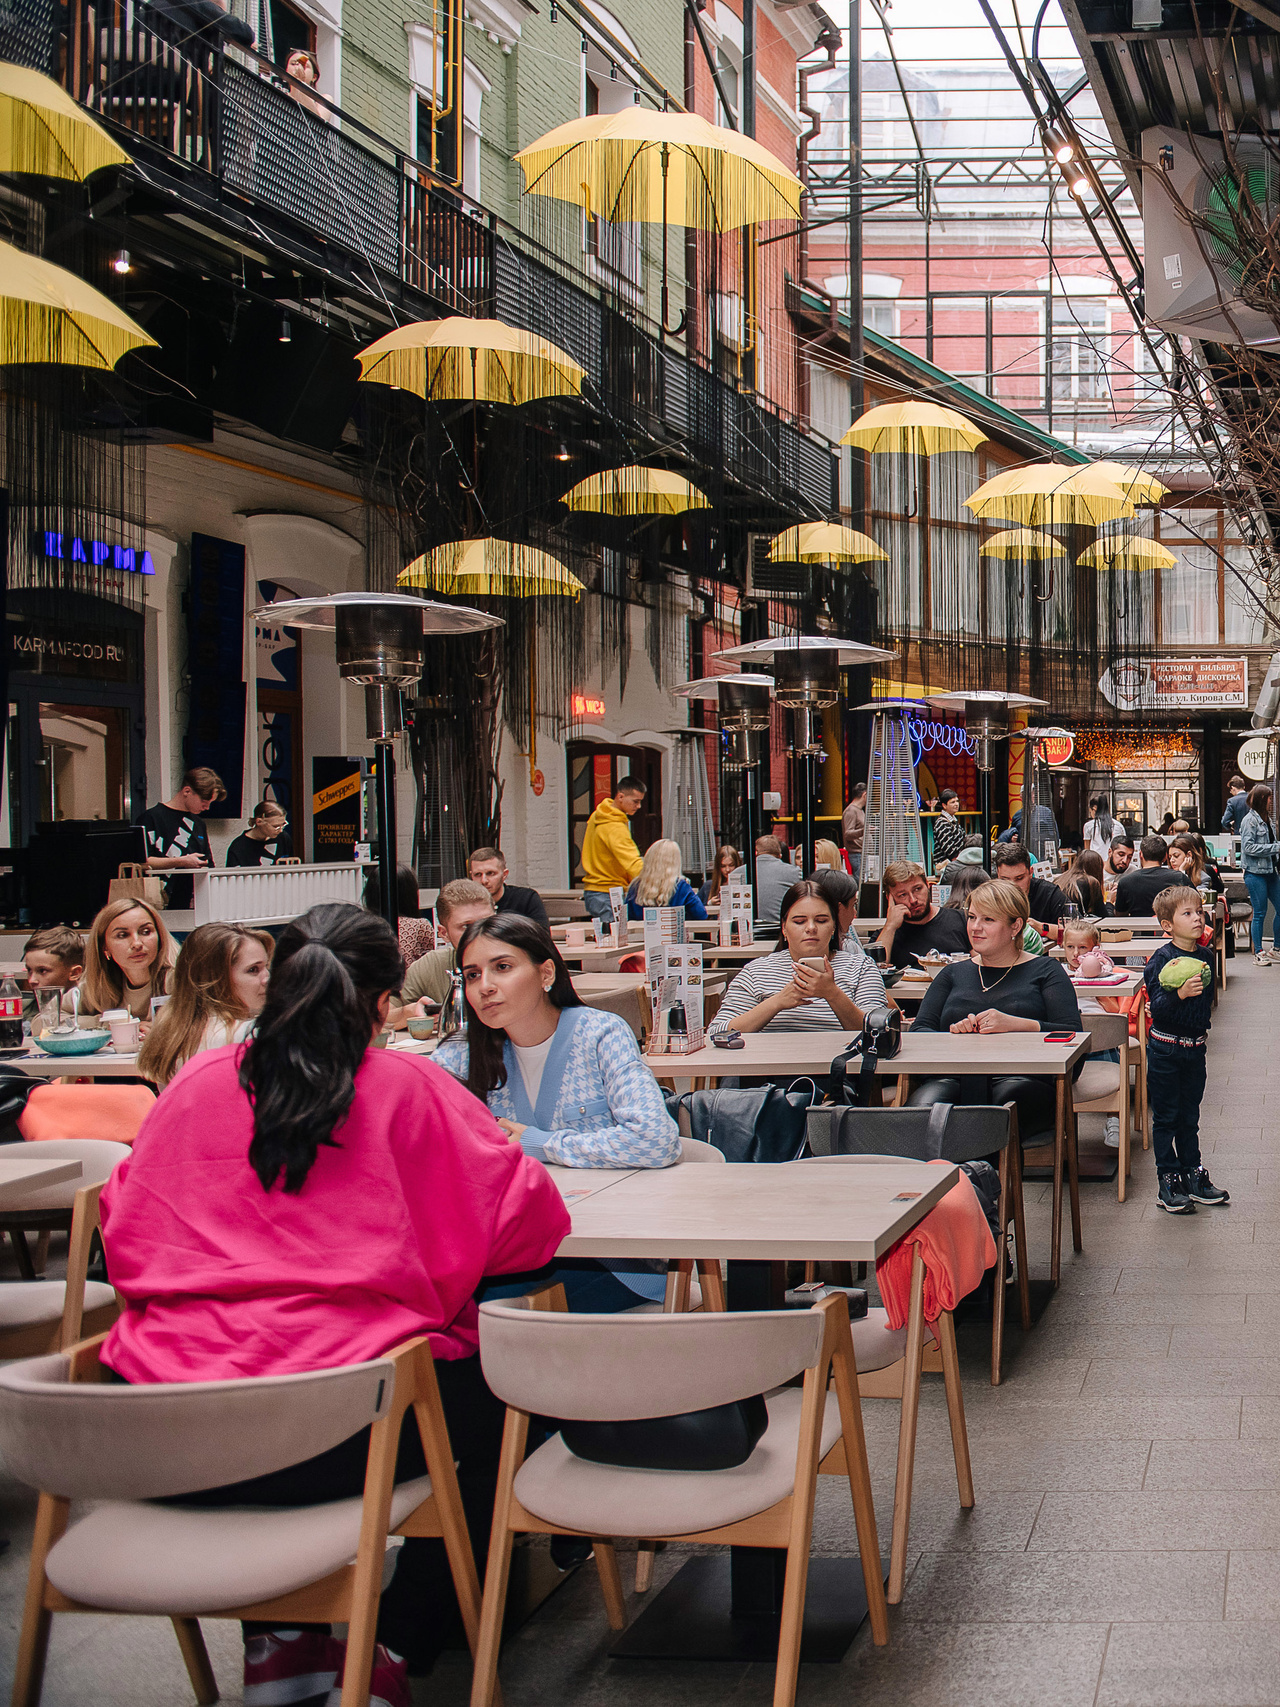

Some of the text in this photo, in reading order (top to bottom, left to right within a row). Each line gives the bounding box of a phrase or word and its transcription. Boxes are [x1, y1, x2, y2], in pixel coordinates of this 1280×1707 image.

[255, 626, 281, 642] РМА
[1200, 664, 1236, 672] БИЛЬЯРД
[1158, 674, 1241, 682] КАРАОКЕ ДИСКОТЕКА
[1190, 694, 1223, 703] Кирова
[1225, 693, 1243, 701] С.М.
[318, 781, 355, 806] Schweppes
[320, 830, 354, 838] ХАРАКТЕР
